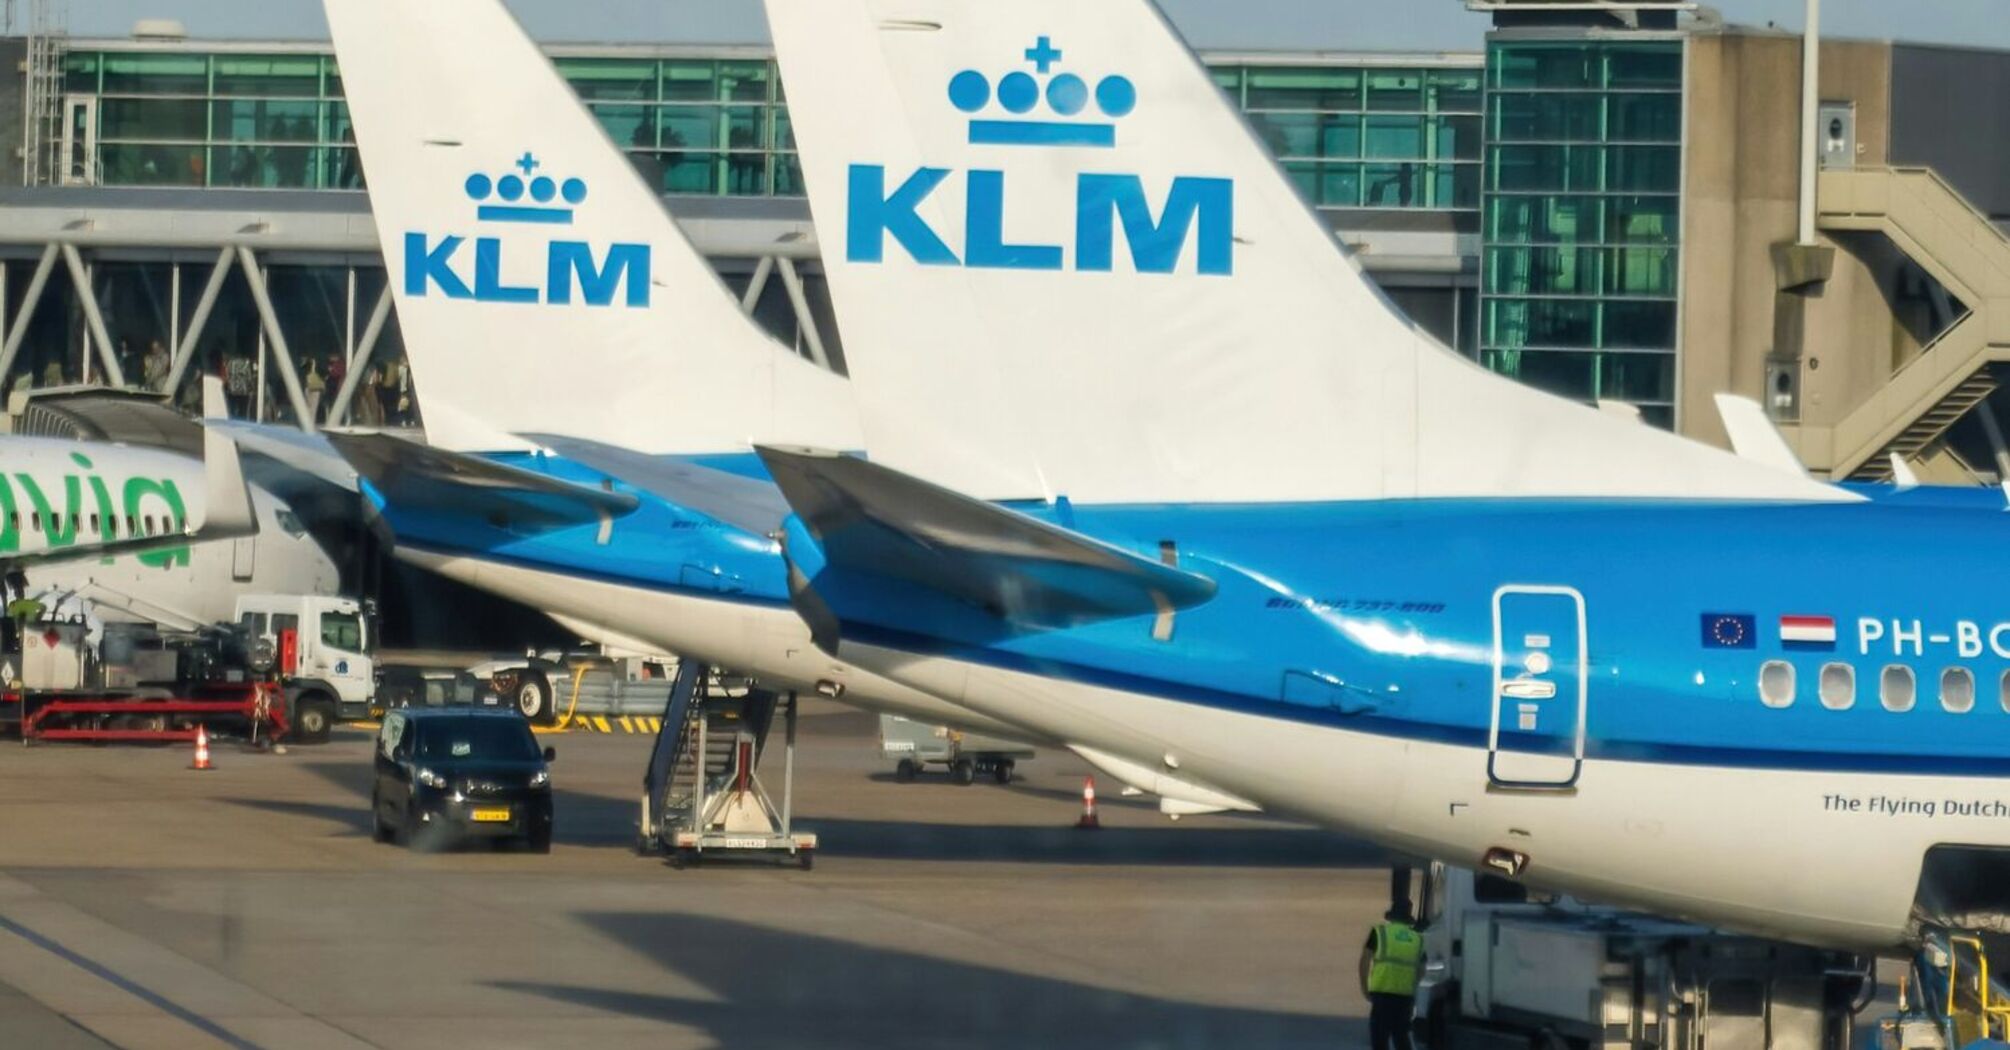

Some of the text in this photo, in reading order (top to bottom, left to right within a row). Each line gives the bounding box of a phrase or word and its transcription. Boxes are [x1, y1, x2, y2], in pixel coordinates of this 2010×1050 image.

[847, 163, 1233, 275] KLM
[404, 232, 651, 307] KLM
[1266, 597, 1348, 610] BOENG
[1823, 794, 2010, 818] The Flying Dutch
